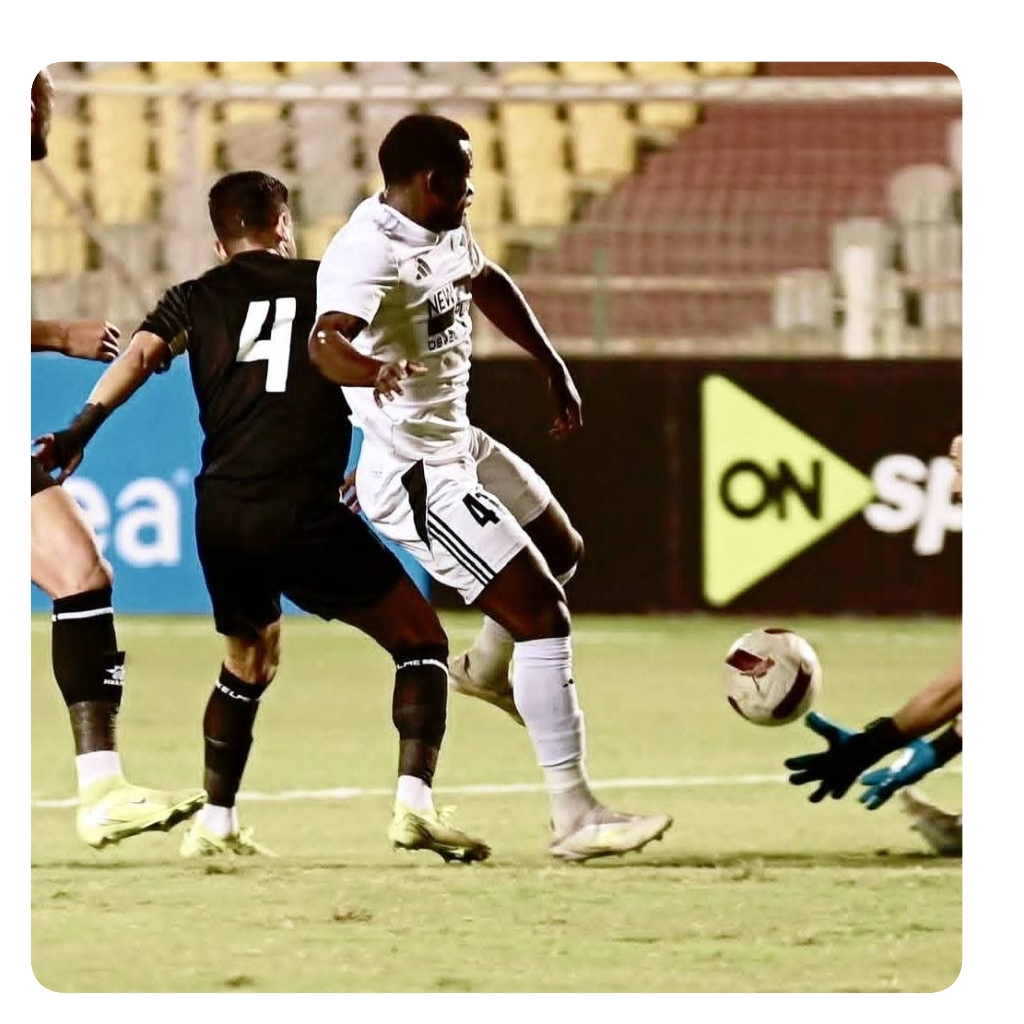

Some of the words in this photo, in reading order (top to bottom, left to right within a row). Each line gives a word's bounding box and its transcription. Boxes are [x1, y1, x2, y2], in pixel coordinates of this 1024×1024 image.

[428, 282, 455, 318] NEW
[236, 297, 296, 392] 4
[462, 492, 504, 528] 4
[719, 459, 823, 520] ON
